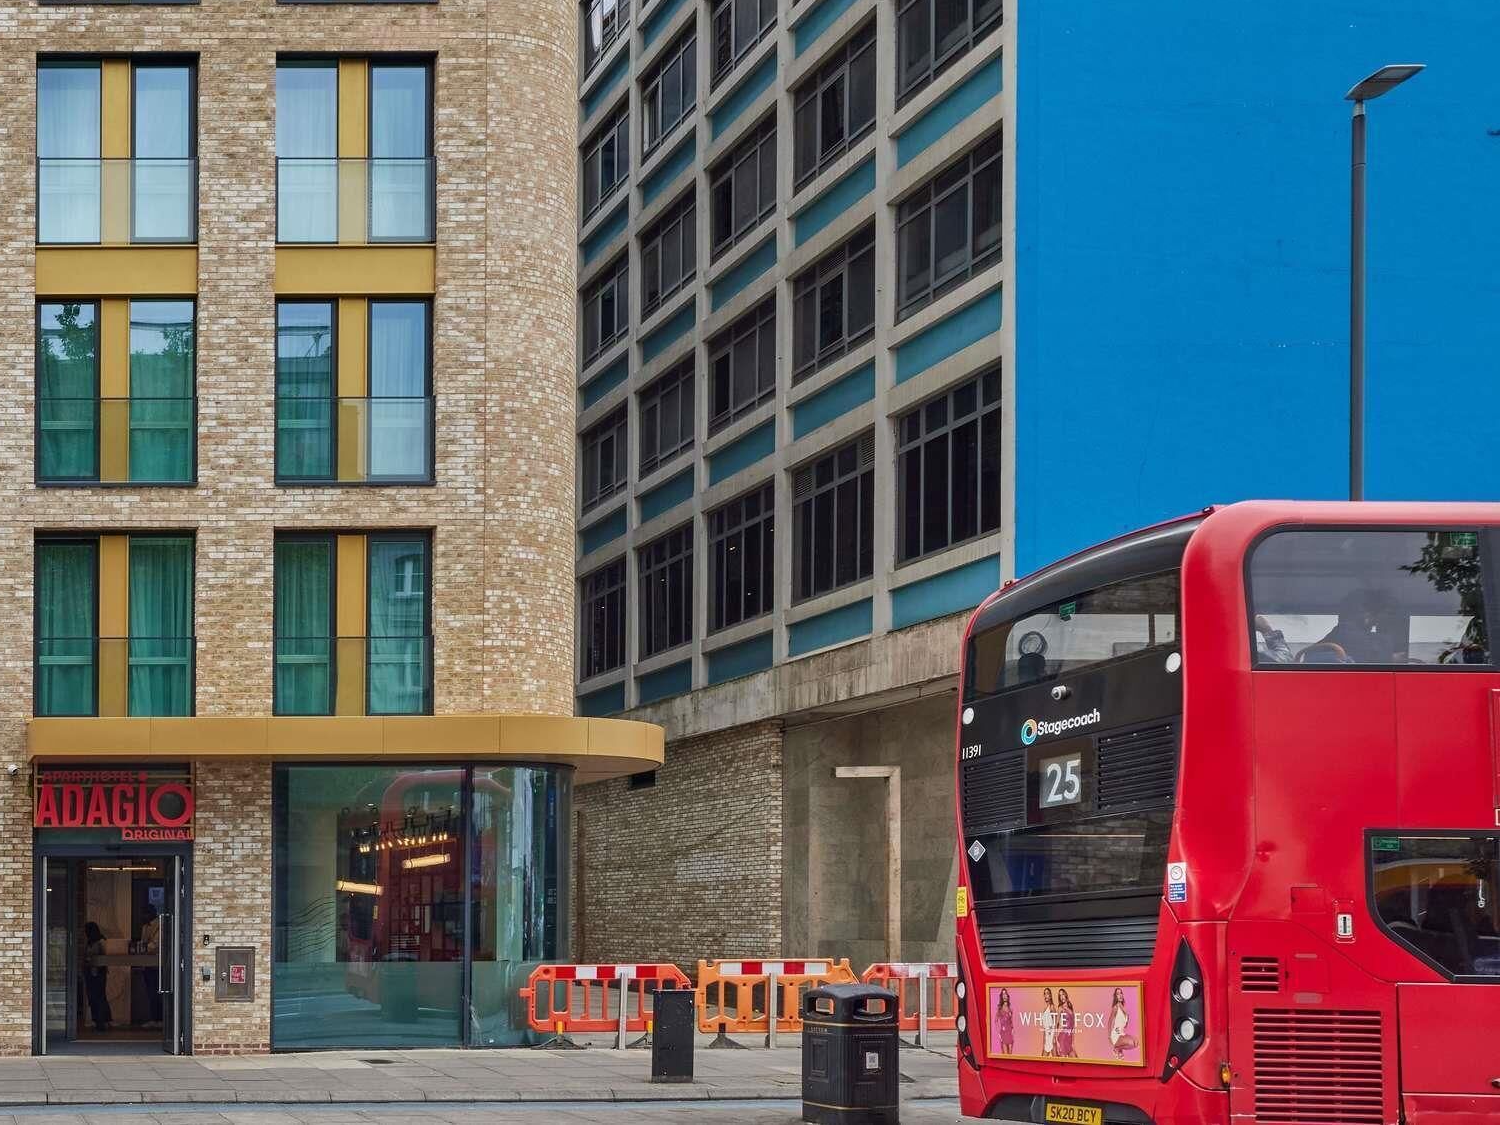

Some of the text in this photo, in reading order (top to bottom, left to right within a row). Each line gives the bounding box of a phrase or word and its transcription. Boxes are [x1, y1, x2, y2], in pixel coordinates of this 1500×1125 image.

[1037, 708, 1101, 736] Stagecoach
[962, 744, 982, 759] 11391
[1046, 759, 1080, 802] 25
[1019, 1012, 1105, 1028] WHTE FOX
[1050, 1105, 1097, 1124] SK20 BCY
